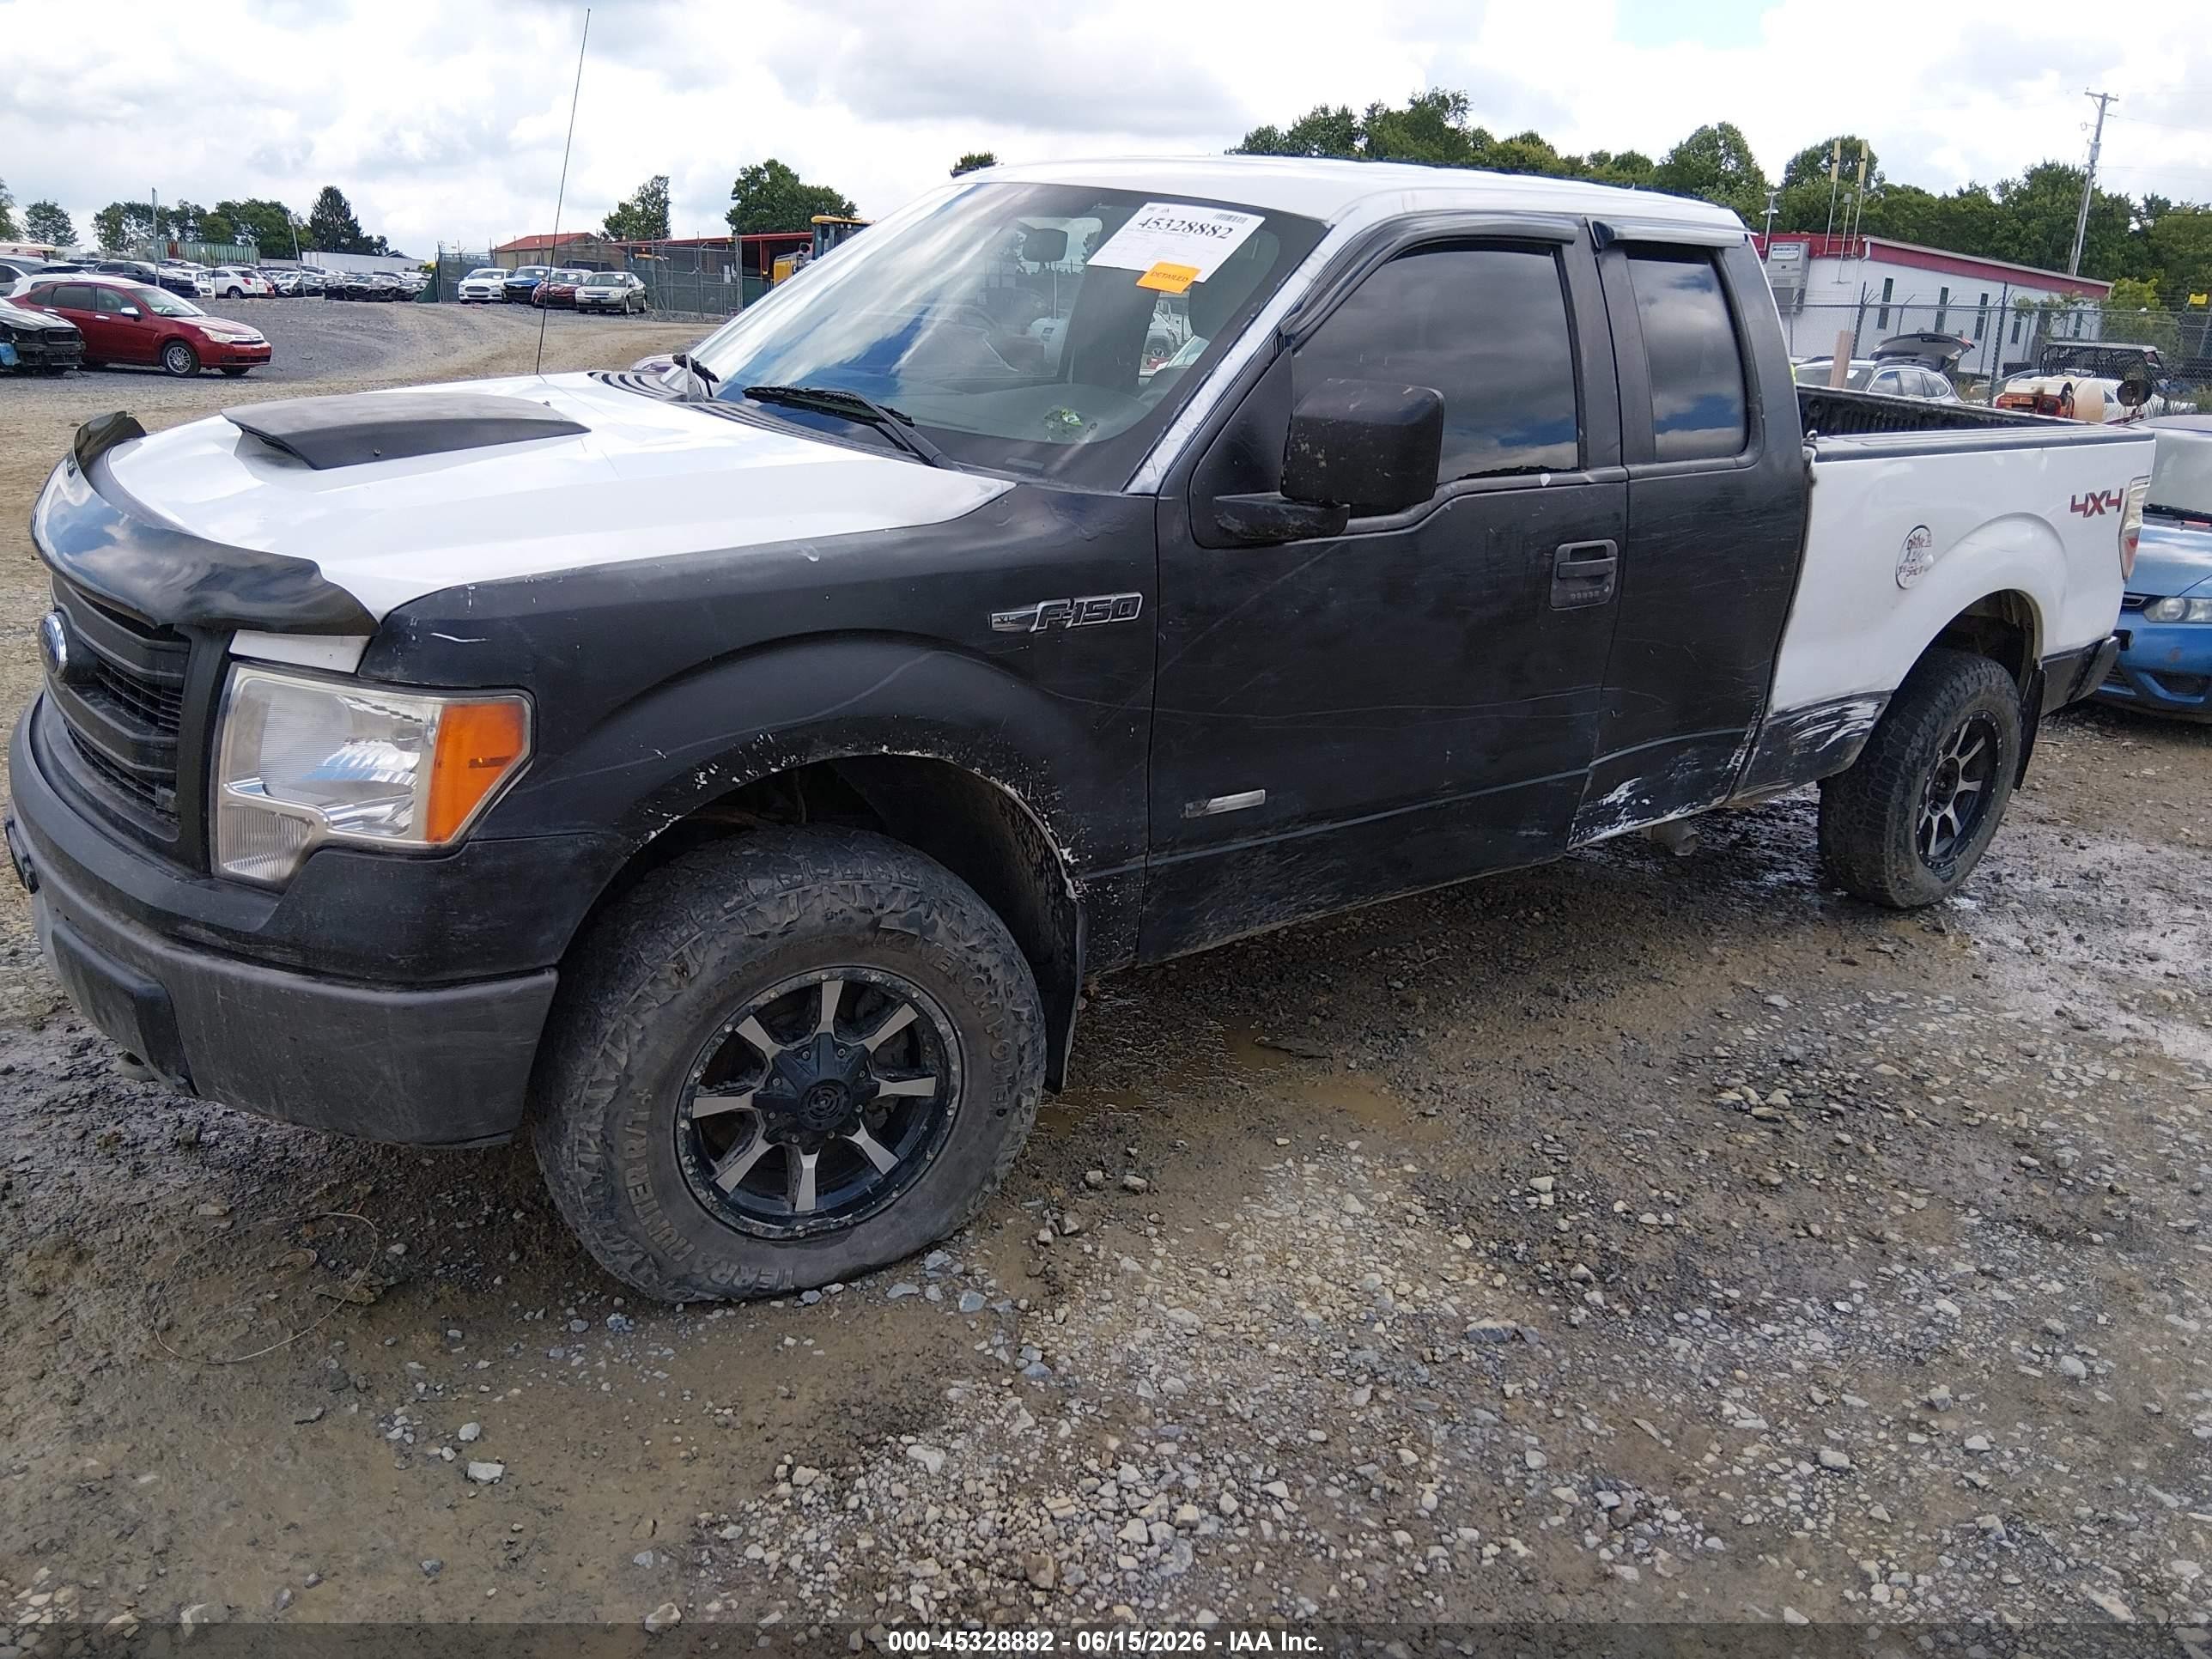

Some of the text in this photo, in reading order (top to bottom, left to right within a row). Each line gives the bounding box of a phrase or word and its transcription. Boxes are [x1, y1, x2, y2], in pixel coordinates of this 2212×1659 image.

[1138, 216, 1235, 240] 45328882
[1150, 270, 1190, 283] DETAILED
[2069, 488, 2124, 518] 4X4
[1030, 592, 1144, 632] F-150
[625, 1163, 695, 1262] HUNTER
[691, 1253, 795, 1291] TERRA
